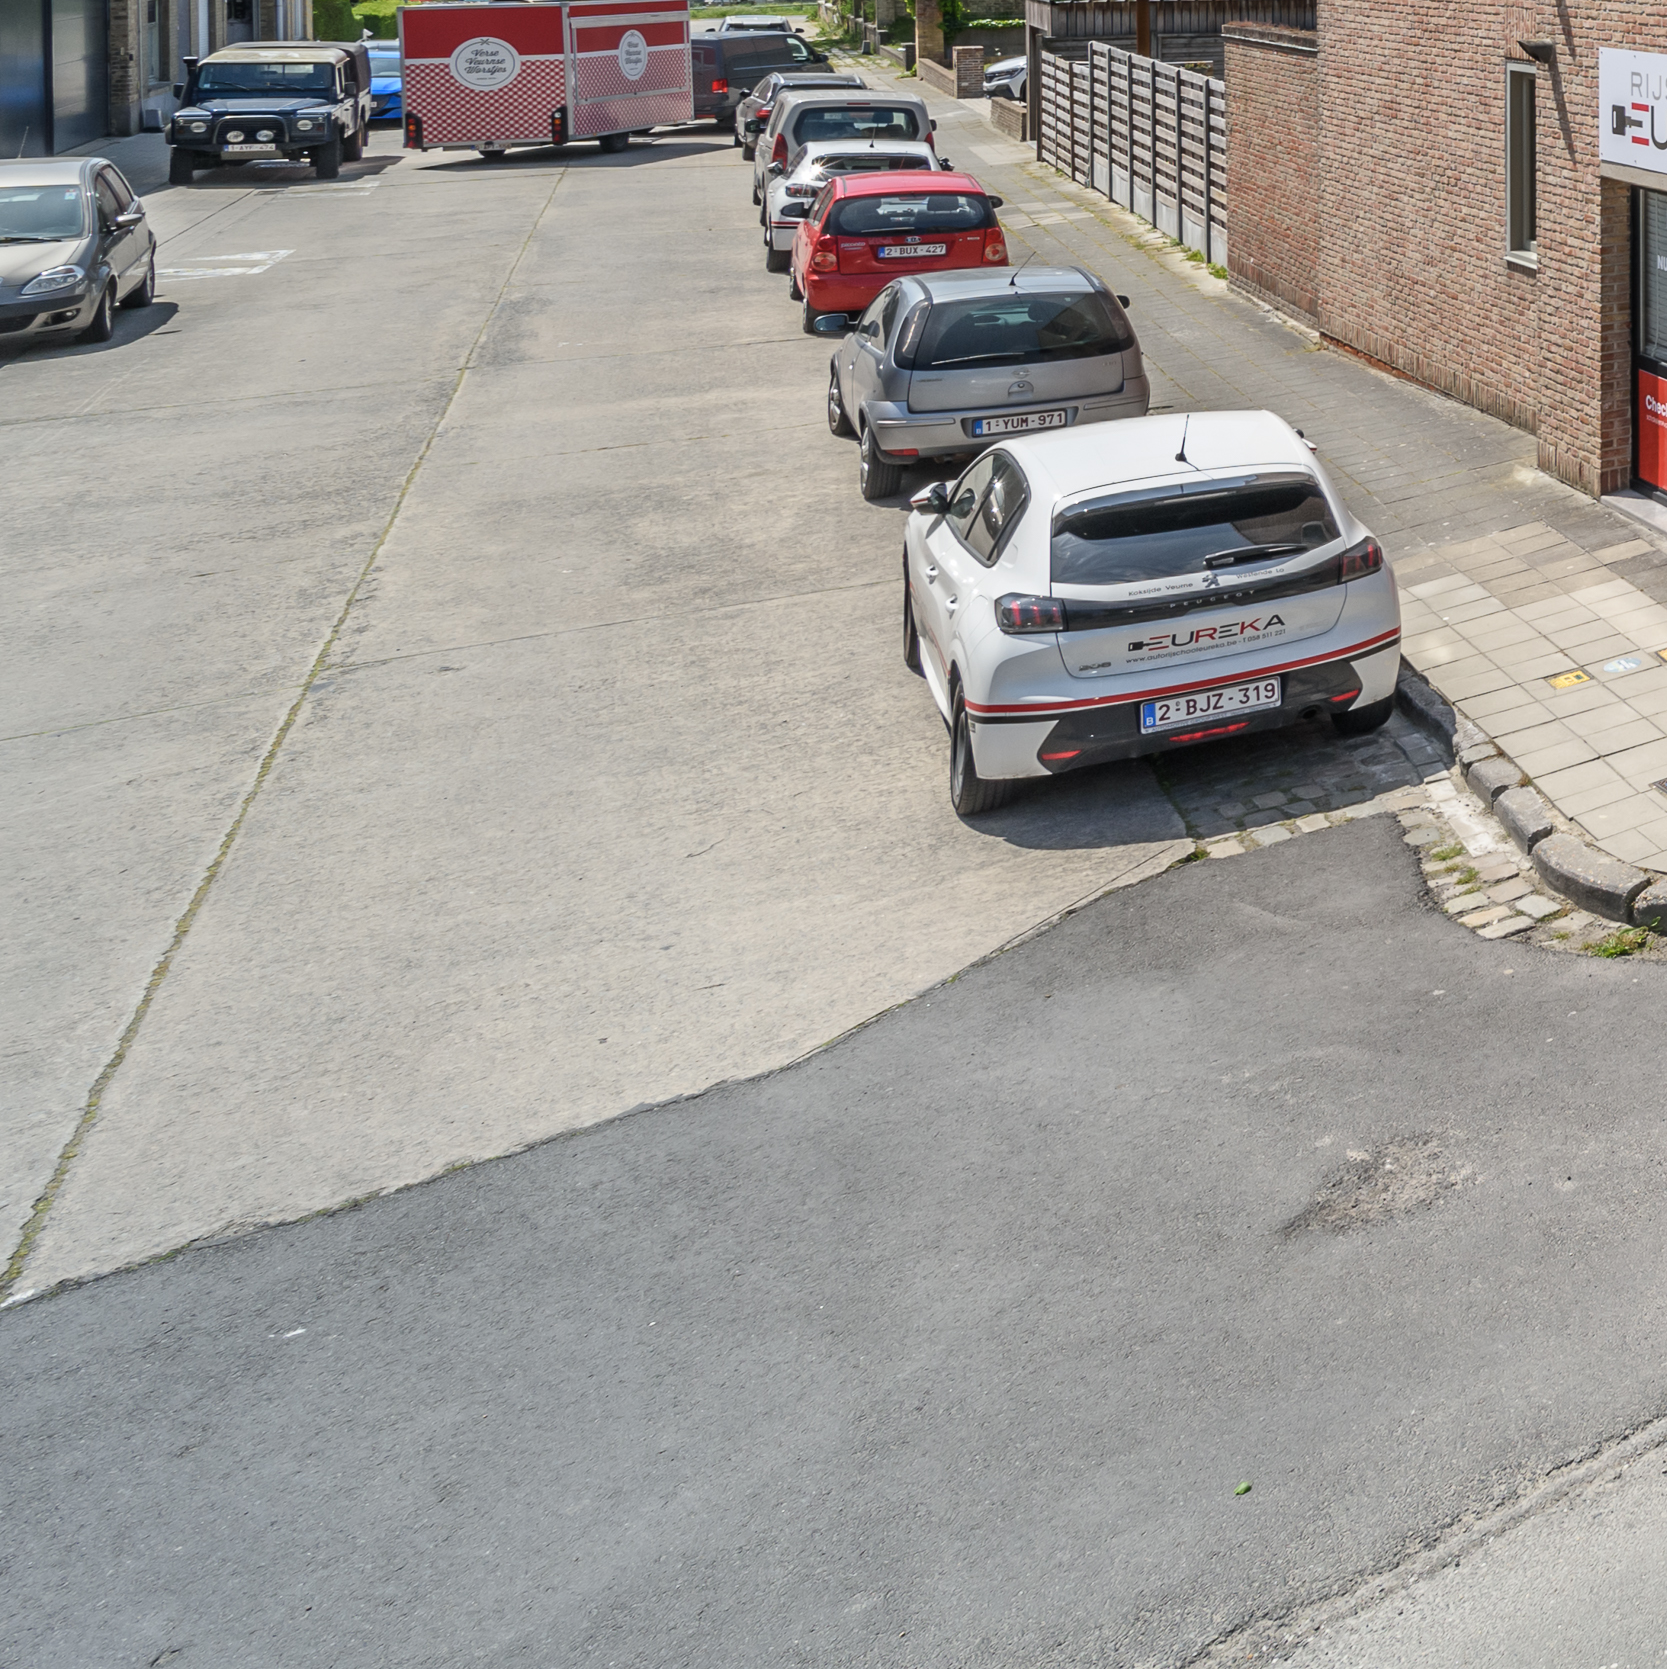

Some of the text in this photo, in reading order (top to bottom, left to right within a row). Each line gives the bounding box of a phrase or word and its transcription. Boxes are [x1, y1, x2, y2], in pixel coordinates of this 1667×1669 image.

[471, 49, 499, 57] Verse
[886, 245, 944, 256] 2-BUX-427
[1657, 255, 1667, 271] NU
[986, 413, 1063, 431] 1-YUM-971
[1128, 586, 1161, 597] Koksijde
[1165, 582, 1193, 590] Veurne
[1170, 590, 1254, 607] PEUGEOT
[1148, 614, 1285, 651] EUREKA
[1126, 641, 1237, 664] www.autorijschooleureka.be
[1146, 717, 1153, 725] B
[1159, 683, 1275, 721] 2-BJZ-319
